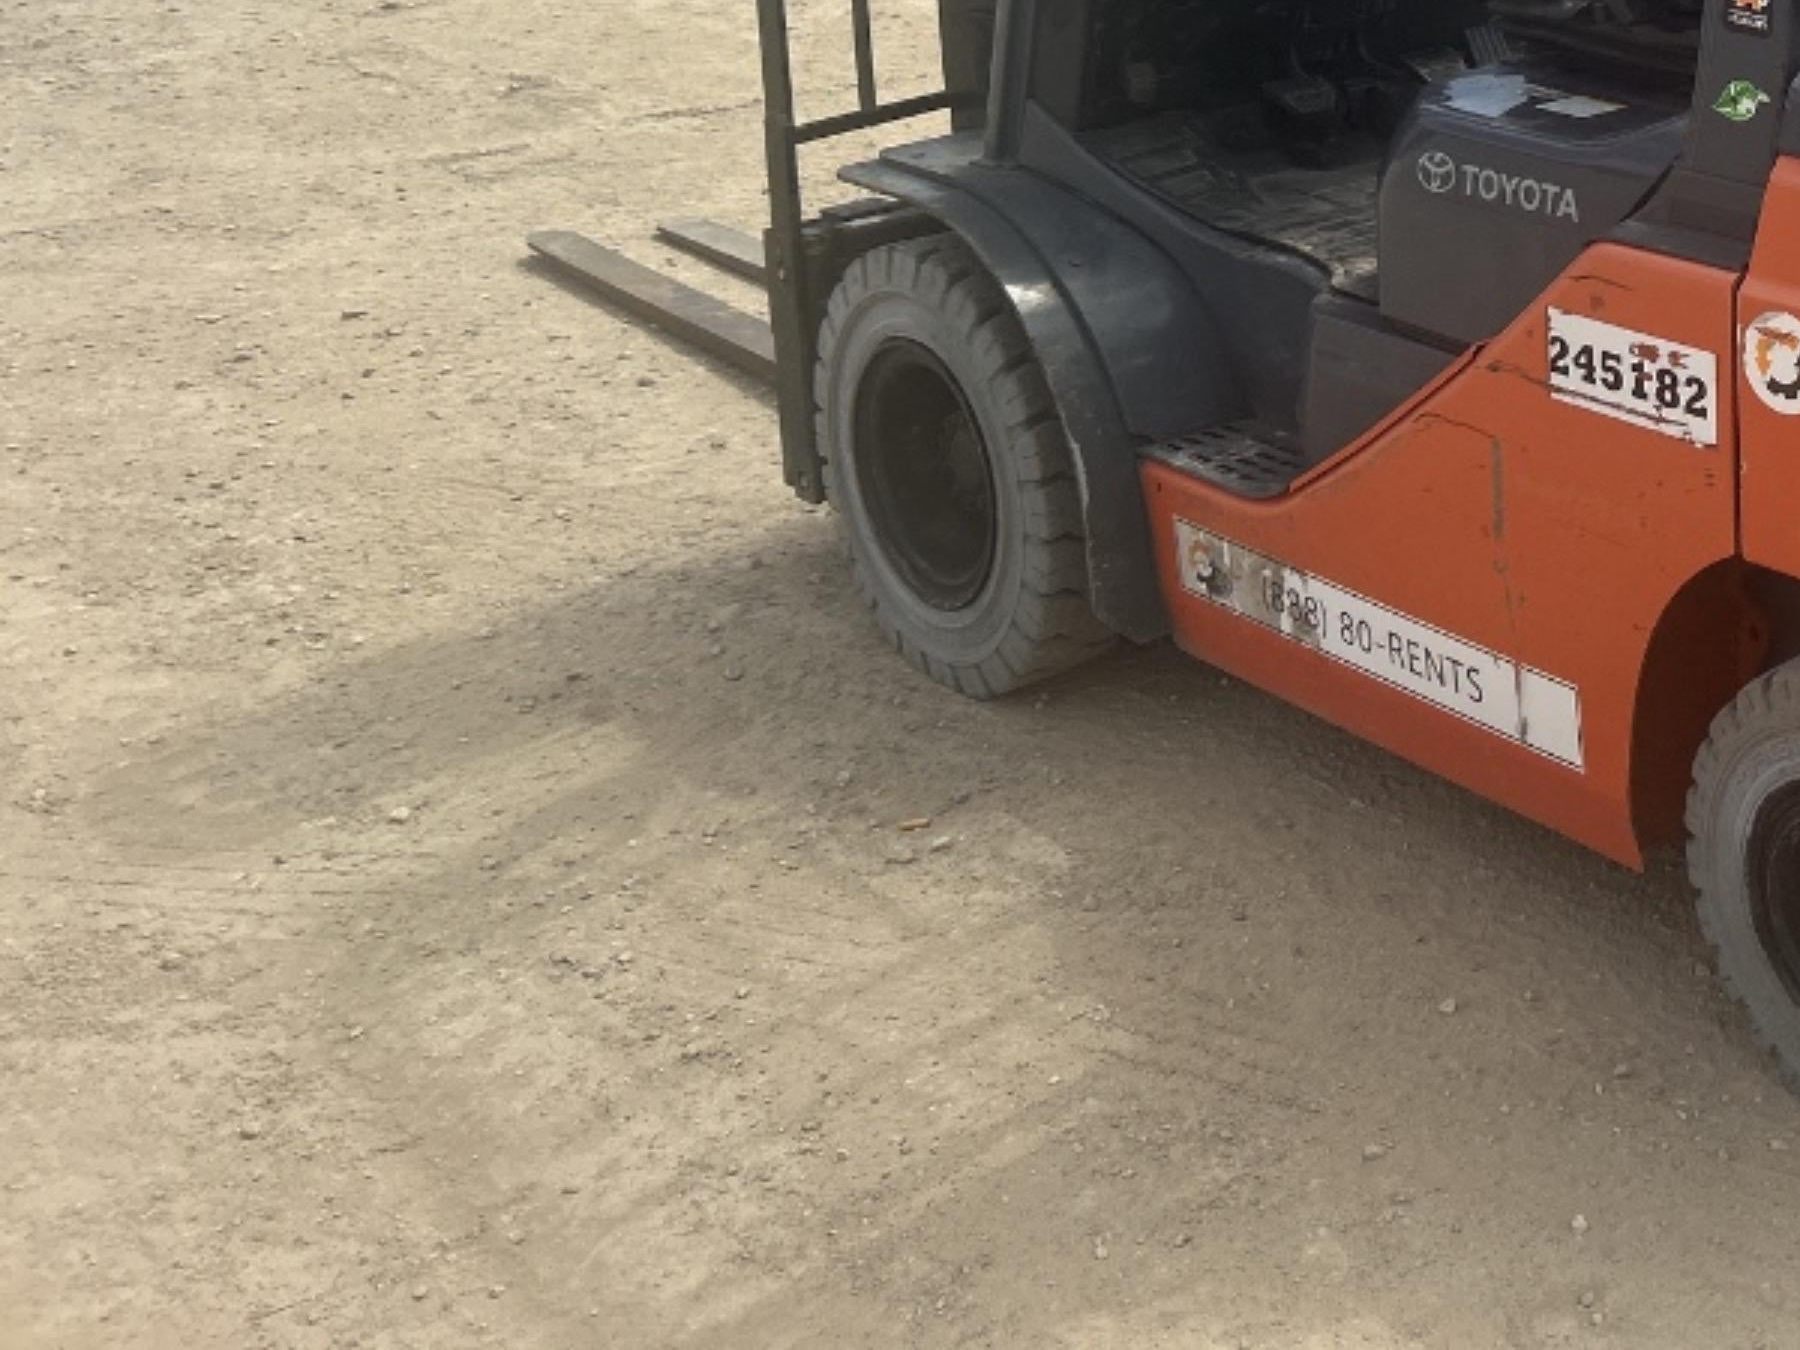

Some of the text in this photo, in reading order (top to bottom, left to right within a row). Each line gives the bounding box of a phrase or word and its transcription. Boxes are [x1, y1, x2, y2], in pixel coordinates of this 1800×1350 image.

[1461, 164, 1579, 223] TOYOTA
[1549, 334, 1709, 421] 245182
[1339, 610, 1485, 705] 80-RENTS
